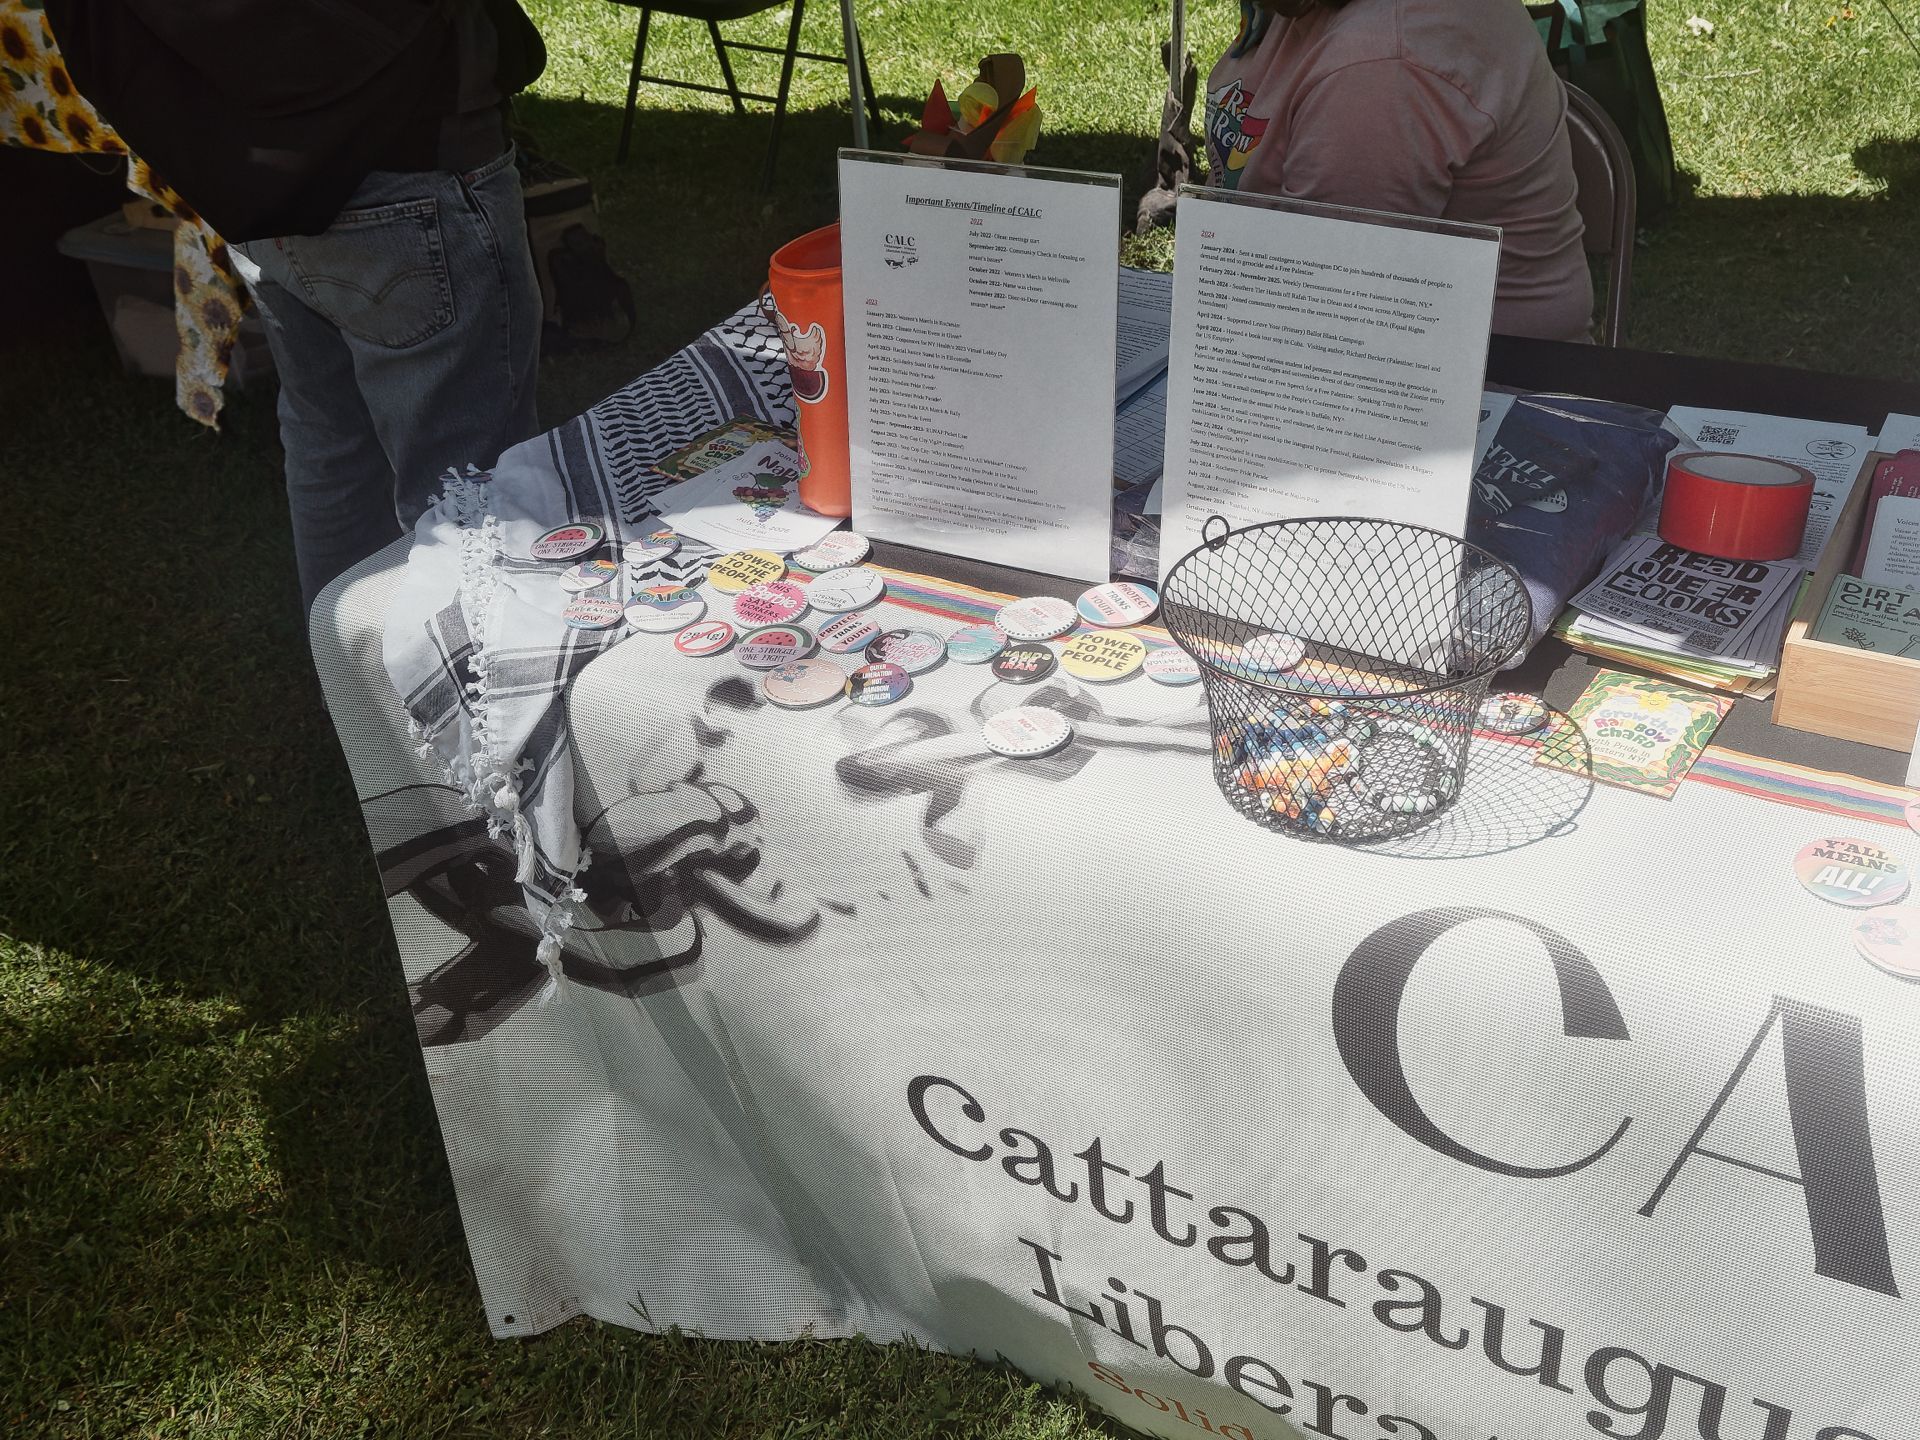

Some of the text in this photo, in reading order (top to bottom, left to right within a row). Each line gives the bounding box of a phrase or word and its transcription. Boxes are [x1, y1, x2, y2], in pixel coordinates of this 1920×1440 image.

[905, 194, 1042, 219] Important Events/Timeline of CALC
[885, 234, 915, 247] CALC
[968, 242, 993, 251] September
[969, 266, 987, 274] October
[1199, 265, 1222, 275] February
[1223, 269, 1235, 277] 2024
[1240, 272, 1266, 282] November
[1282, 278, 1300, 287] Weekly
[1200, 244, 1221, 253] January
[1222, 247, 1234, 255] 2024
[1254, 252, 1267, 260] small
[1302, 259, 1332, 270] Washington
[1332, 265, 1342, 273] DC
[1349, 267, 1359, 275] join
[1360, 269, 1384, 279] hundreds
[1392, 274, 1419, 284] thousands
[1427, 279, 1445, 288] people
[1446, 282, 1453, 290] to
[1198, 277, 1215, 286] March
[1216, 280, 1228, 288] 2024
[1392, 310, 1414, 320] Allegany
[1346, 350, 1366, 360] Richard
[1367, 353, 1385, 363] Becker
[775, 451, 792, 462] Join
[726, 558, 770, 578] TO THE
[734, 551, 780, 572] POWER
[710, 563, 761, 586] PEOPLE
[1623, 559, 1762, 605] QUEER
[744, 585, 797, 608] Barbie
[768, 582, 792, 593] THIS
[1118, 583, 1151, 610] PROTECT
[1843, 582, 1911, 604] DIRT
[746, 596, 775, 609] SAYS
[1090, 595, 1116, 617] YOUTH
[1107, 590, 1132, 610] TRANS
[1603, 571, 1752, 629] BOOKS
[740, 602, 780, 619] WORKERS
[740, 609, 766, 622] UNITE!
[1030, 607, 1049, 618] NOT
[819, 612, 859, 638] PROTECT
[833, 621, 862, 639] TRANS
[841, 626, 872, 645] YOUTH
[1080, 633, 1142, 653] POWER
[741, 653, 758, 661] ONE
[758, 646, 799, 656] STRUGGLE
[1000, 650, 1053, 660] HANDS
[1061, 649, 1127, 671] PEOPLE
[1076, 642, 1097, 653] TO
[1101, 646, 1133, 662] THE
[999, 662, 1038, 672] IRAN
[1017, 717, 1037, 732] NOT
[1614, 740, 1639, 754] Pride
[1824, 839, 1889, 861] Y'ALL
[1812, 848, 1898, 873] MEANS
[1811, 865, 1885, 896] ALL!
[907, 1074, 1866, 1440] Cattaraugu
[1018, 1237, 1500, 1440] Liber
